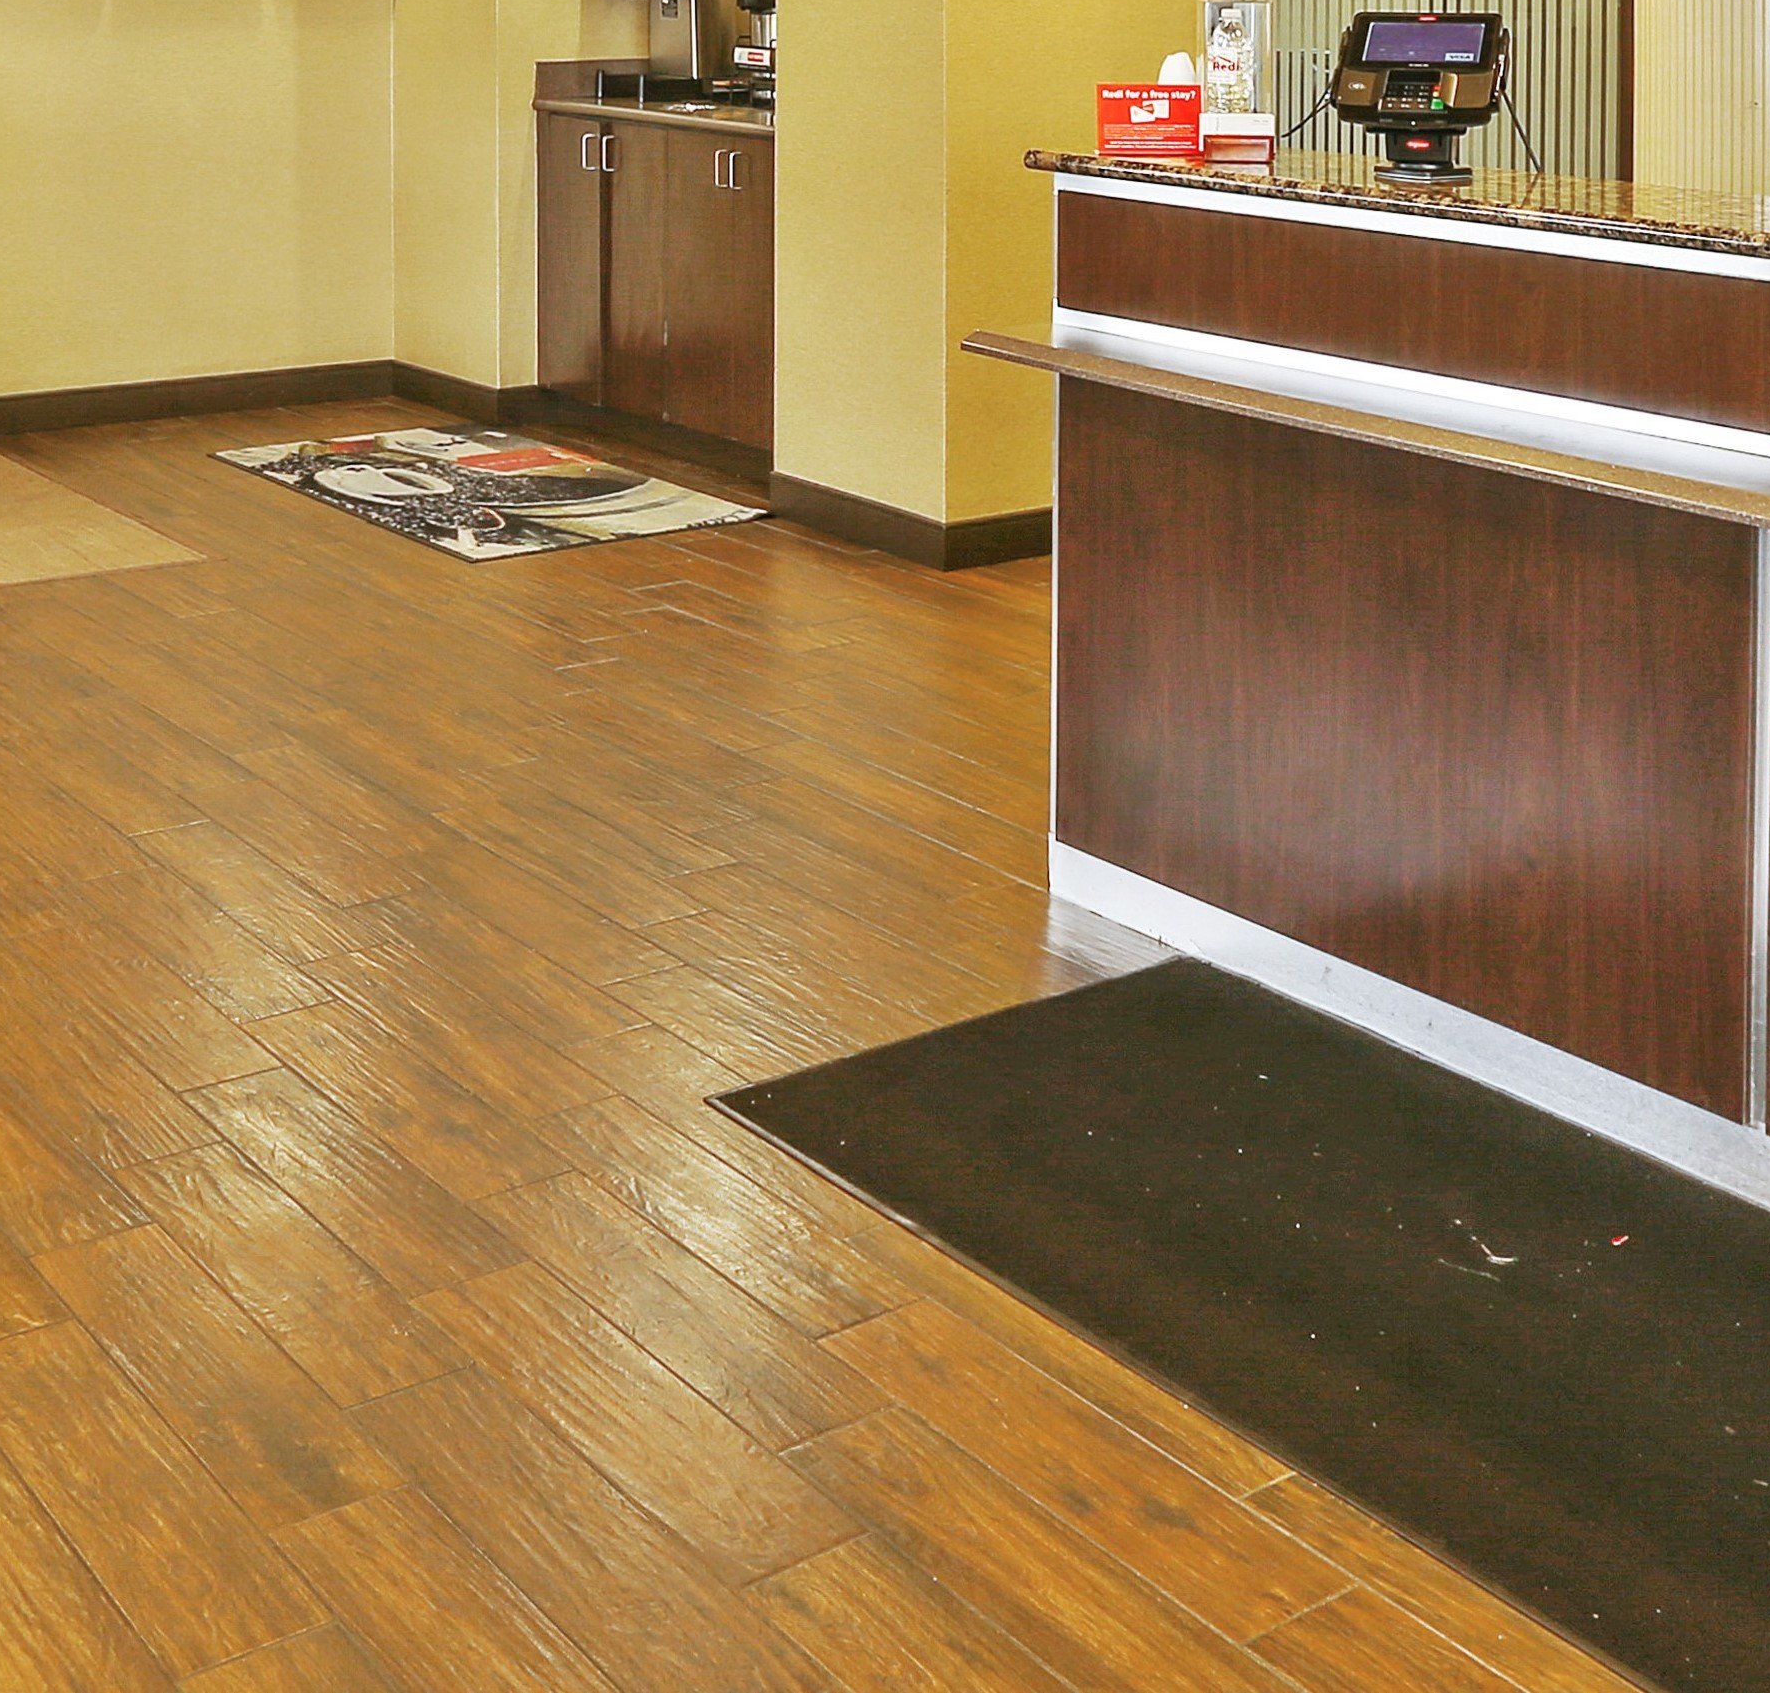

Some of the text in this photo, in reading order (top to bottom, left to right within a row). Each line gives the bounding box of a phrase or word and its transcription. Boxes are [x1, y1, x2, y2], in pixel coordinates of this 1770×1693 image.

[1102, 89, 1196, 101] Redi for a free stay?
